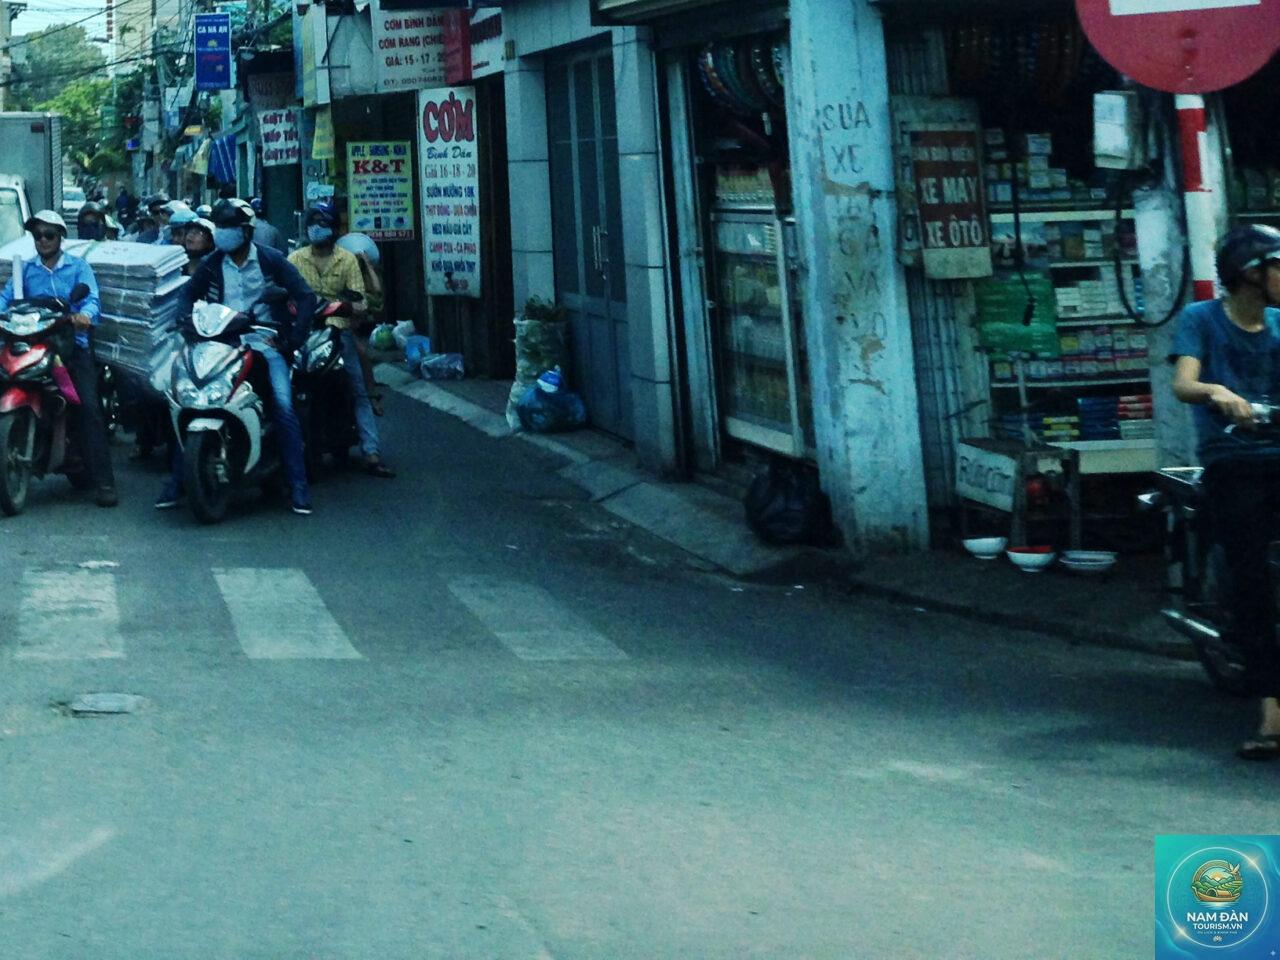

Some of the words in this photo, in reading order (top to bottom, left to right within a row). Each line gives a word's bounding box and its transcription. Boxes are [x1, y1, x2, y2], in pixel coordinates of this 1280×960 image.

[423, 91, 474, 143] CƠM
[353, 159, 405, 174] K&T
[920, 177, 938, 204] XE
[942, 168, 977, 204] MÁY
[926, 221, 946, 247] XE
[949, 214, 982, 247] ÔTÔ
